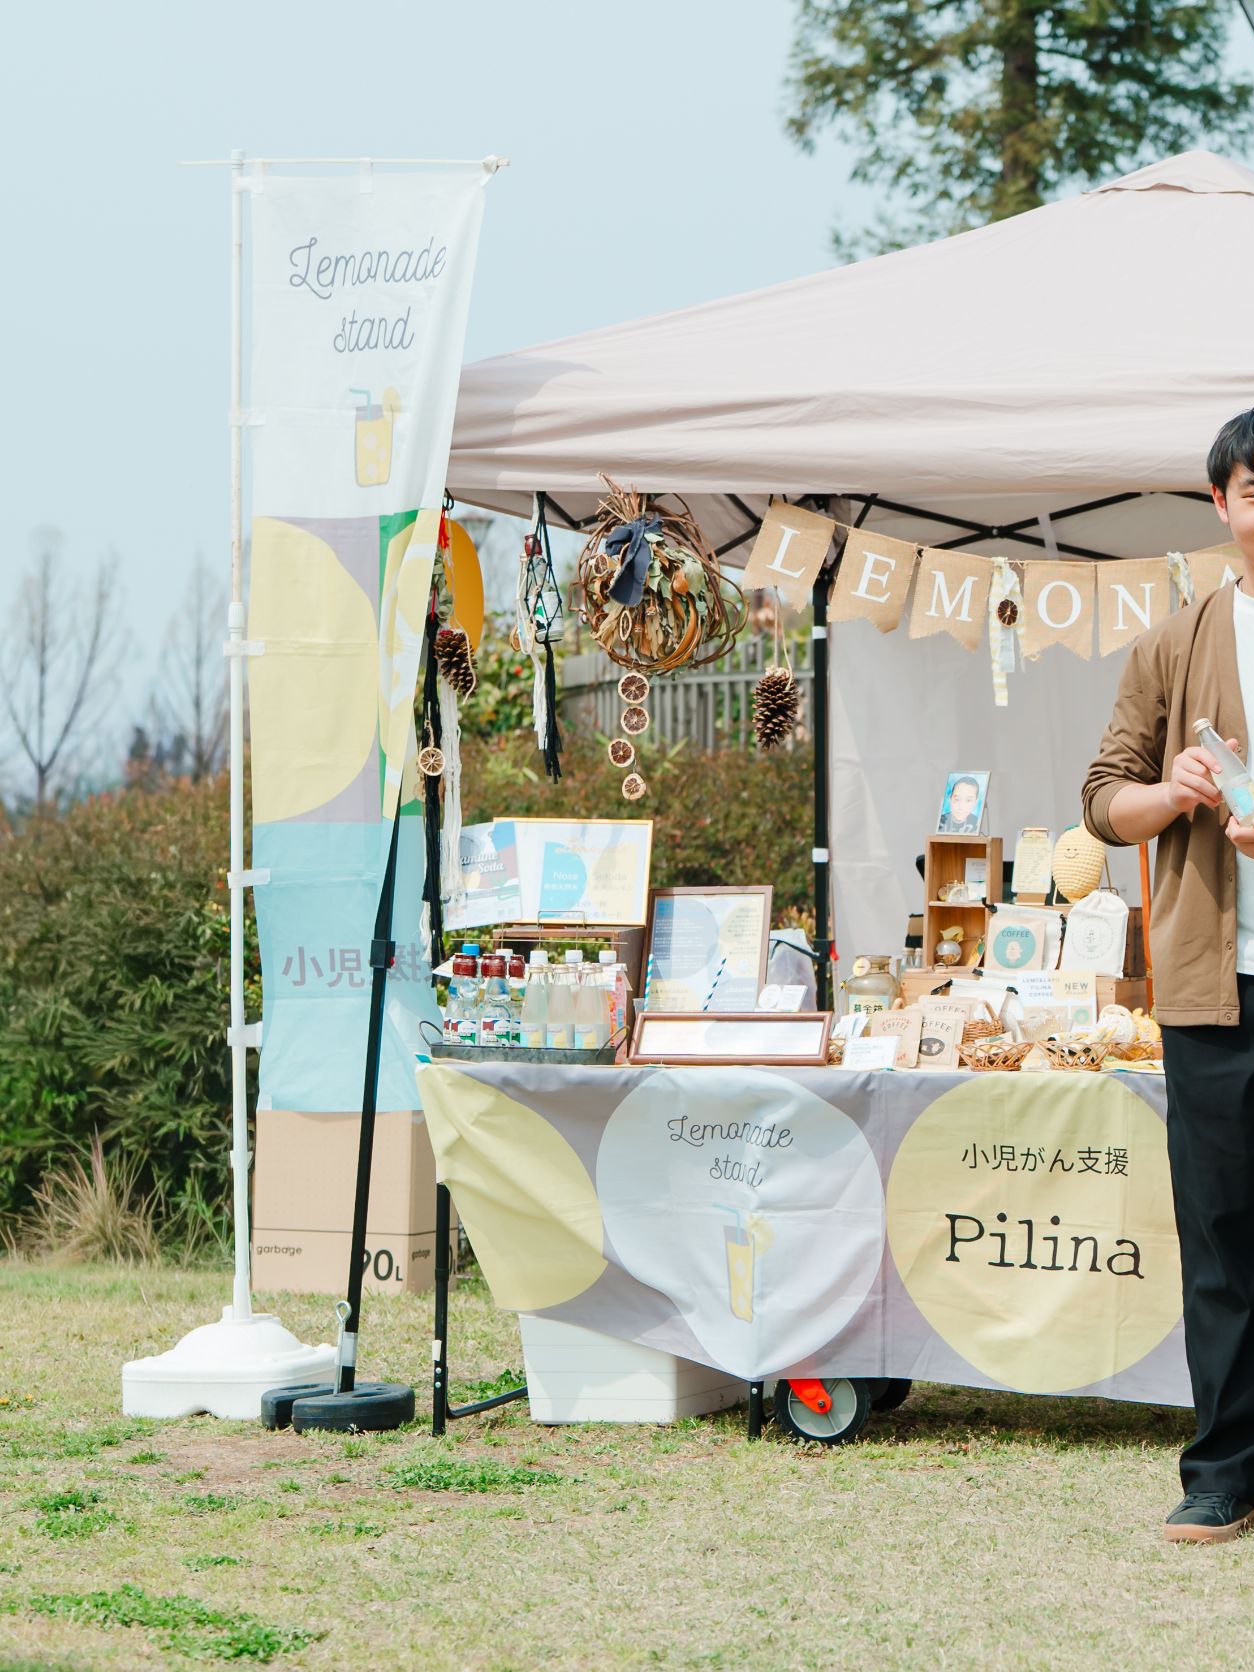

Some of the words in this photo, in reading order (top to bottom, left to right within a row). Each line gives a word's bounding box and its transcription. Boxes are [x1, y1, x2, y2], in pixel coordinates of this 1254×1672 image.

[289, 236, 447, 300] Lemonade
[333, 306, 415, 353] stand
[459, 851, 499, 867] amune
[478, 861, 505, 874] Soda
[1001, 929, 1031, 939] COFFEE
[1064, 981, 1090, 992] NEW
[921, 1020, 953, 1033] OFFEE
[666, 1115, 794, 1148] Lemonade
[960, 1141, 1130, 1177] 小児がん支援
[256, 1244, 303, 1257] garbage
[943, 1211, 1145, 1280] Pilina
